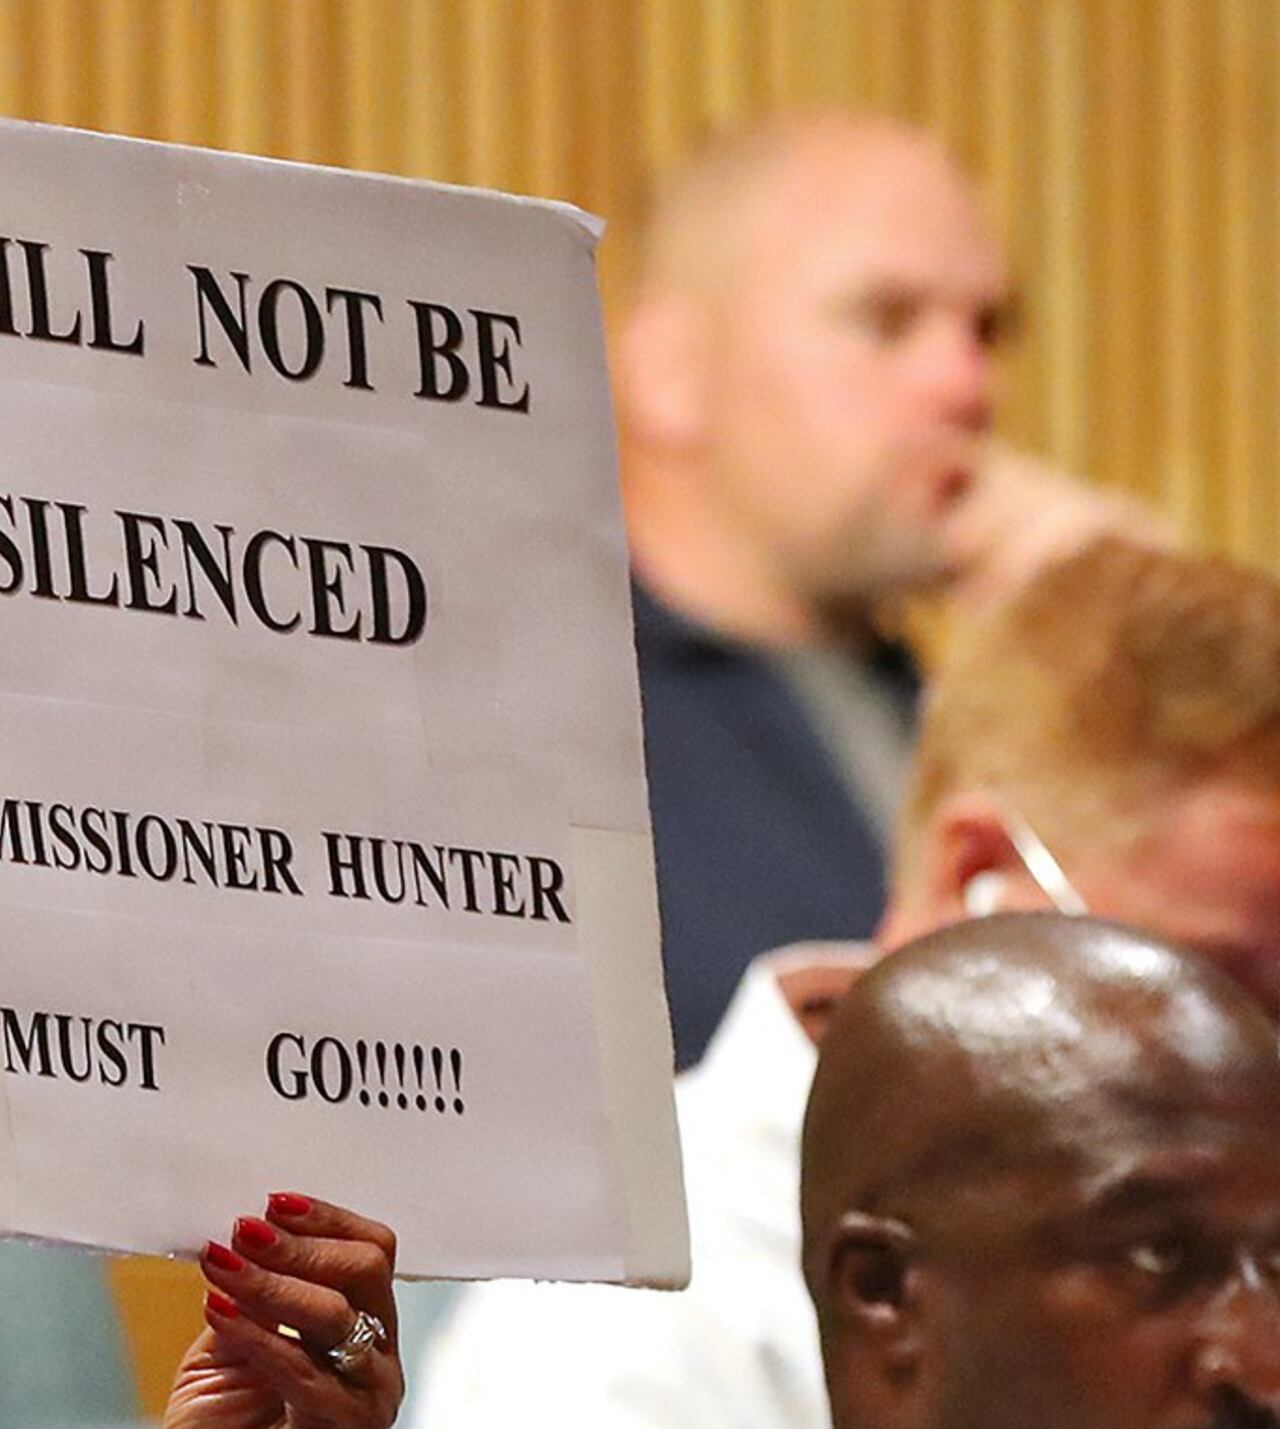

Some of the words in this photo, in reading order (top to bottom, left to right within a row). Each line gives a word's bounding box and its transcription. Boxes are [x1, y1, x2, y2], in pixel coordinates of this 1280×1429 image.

[186, 263, 384, 392] NOT
[406, 298, 531, 415] BE
[320, 830, 572, 925] HUNTER
[264, 1030, 466, 1116] GO!!!!!!
